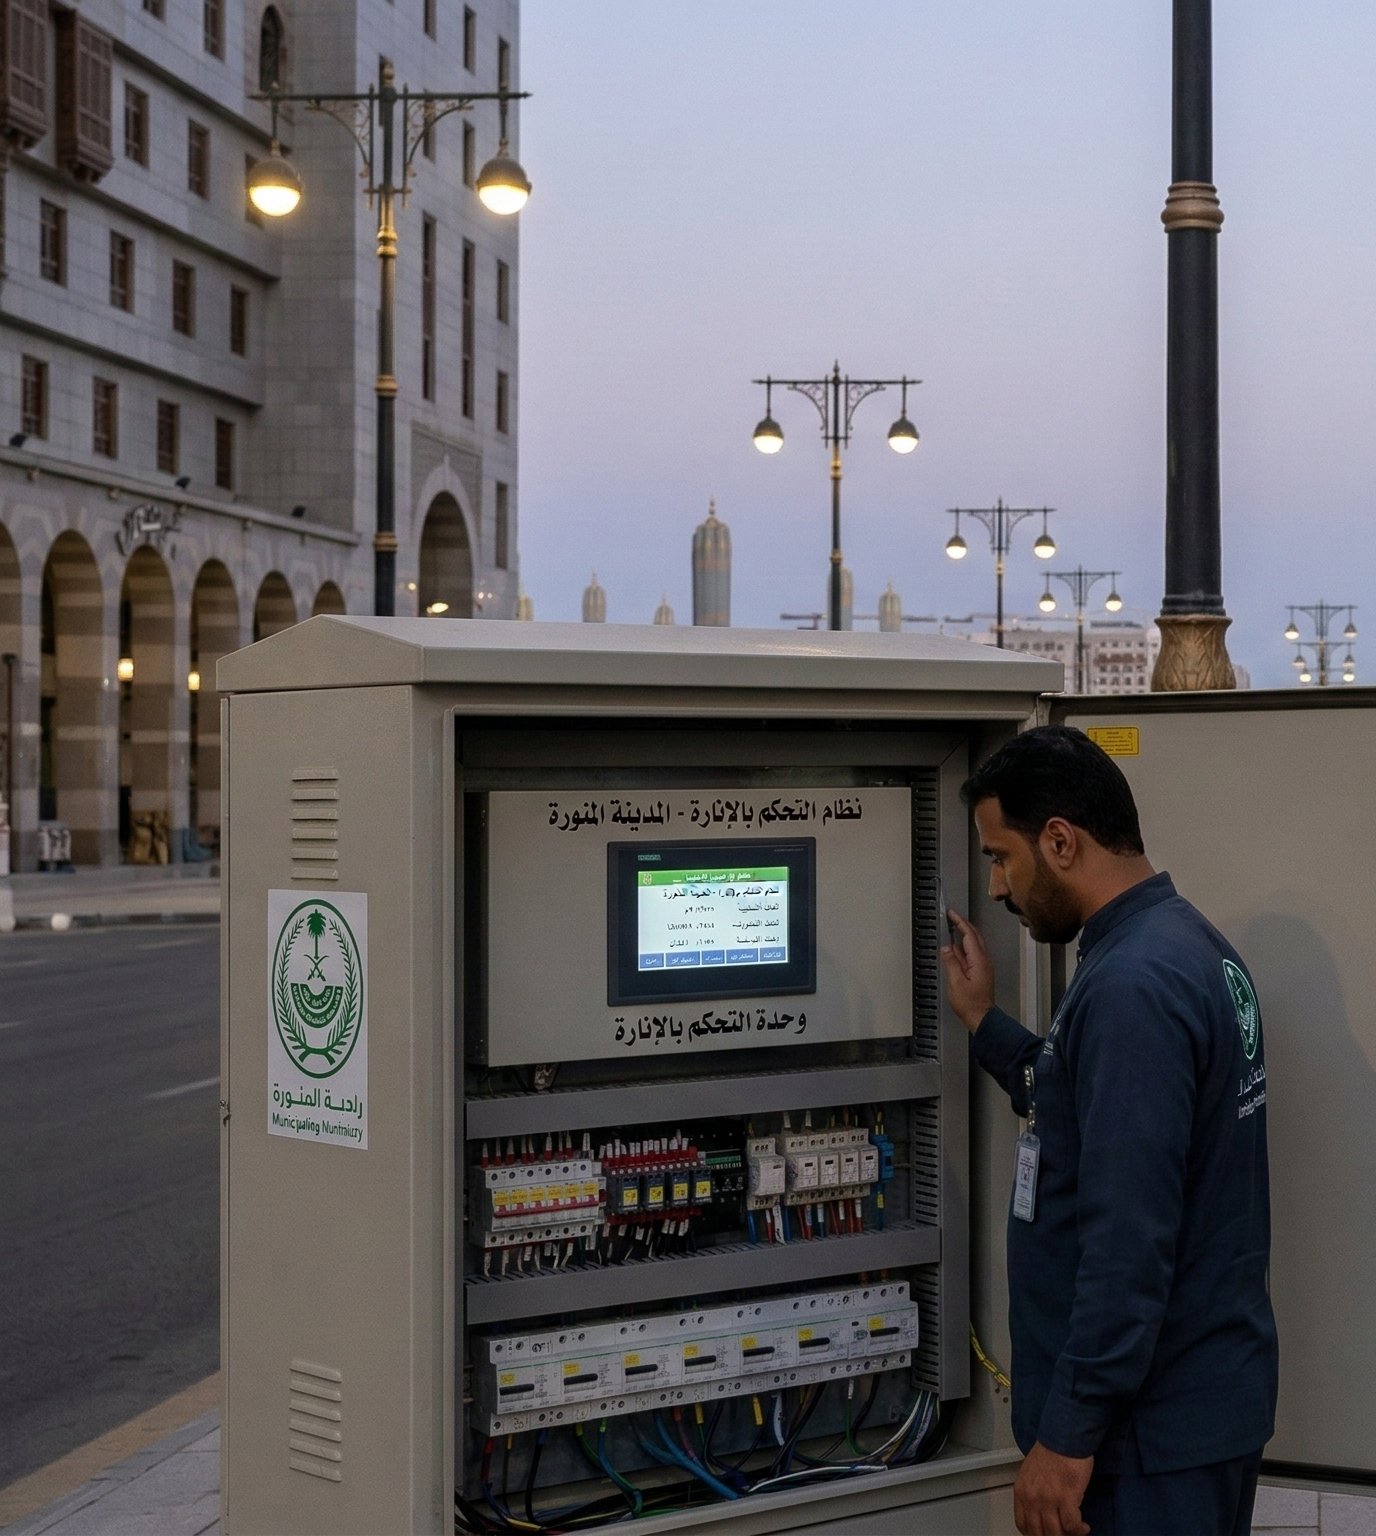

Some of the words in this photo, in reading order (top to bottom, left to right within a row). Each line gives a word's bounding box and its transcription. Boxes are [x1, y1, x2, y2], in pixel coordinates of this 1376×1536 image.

[548, 800, 605, 832] المنورة
[609, 799, 671, 832] المدينة
[690, 798, 754, 830] بالإنارة
[758, 797, 816, 829] التحكم
[822, 797, 863, 827] نظام
[614, 1014, 683, 1046] بالإنارة
[688, 1010, 752, 1042] التحكم
[756, 1008, 807, 1035] وحدة
[273, 1082, 321, 1109] المنورة
